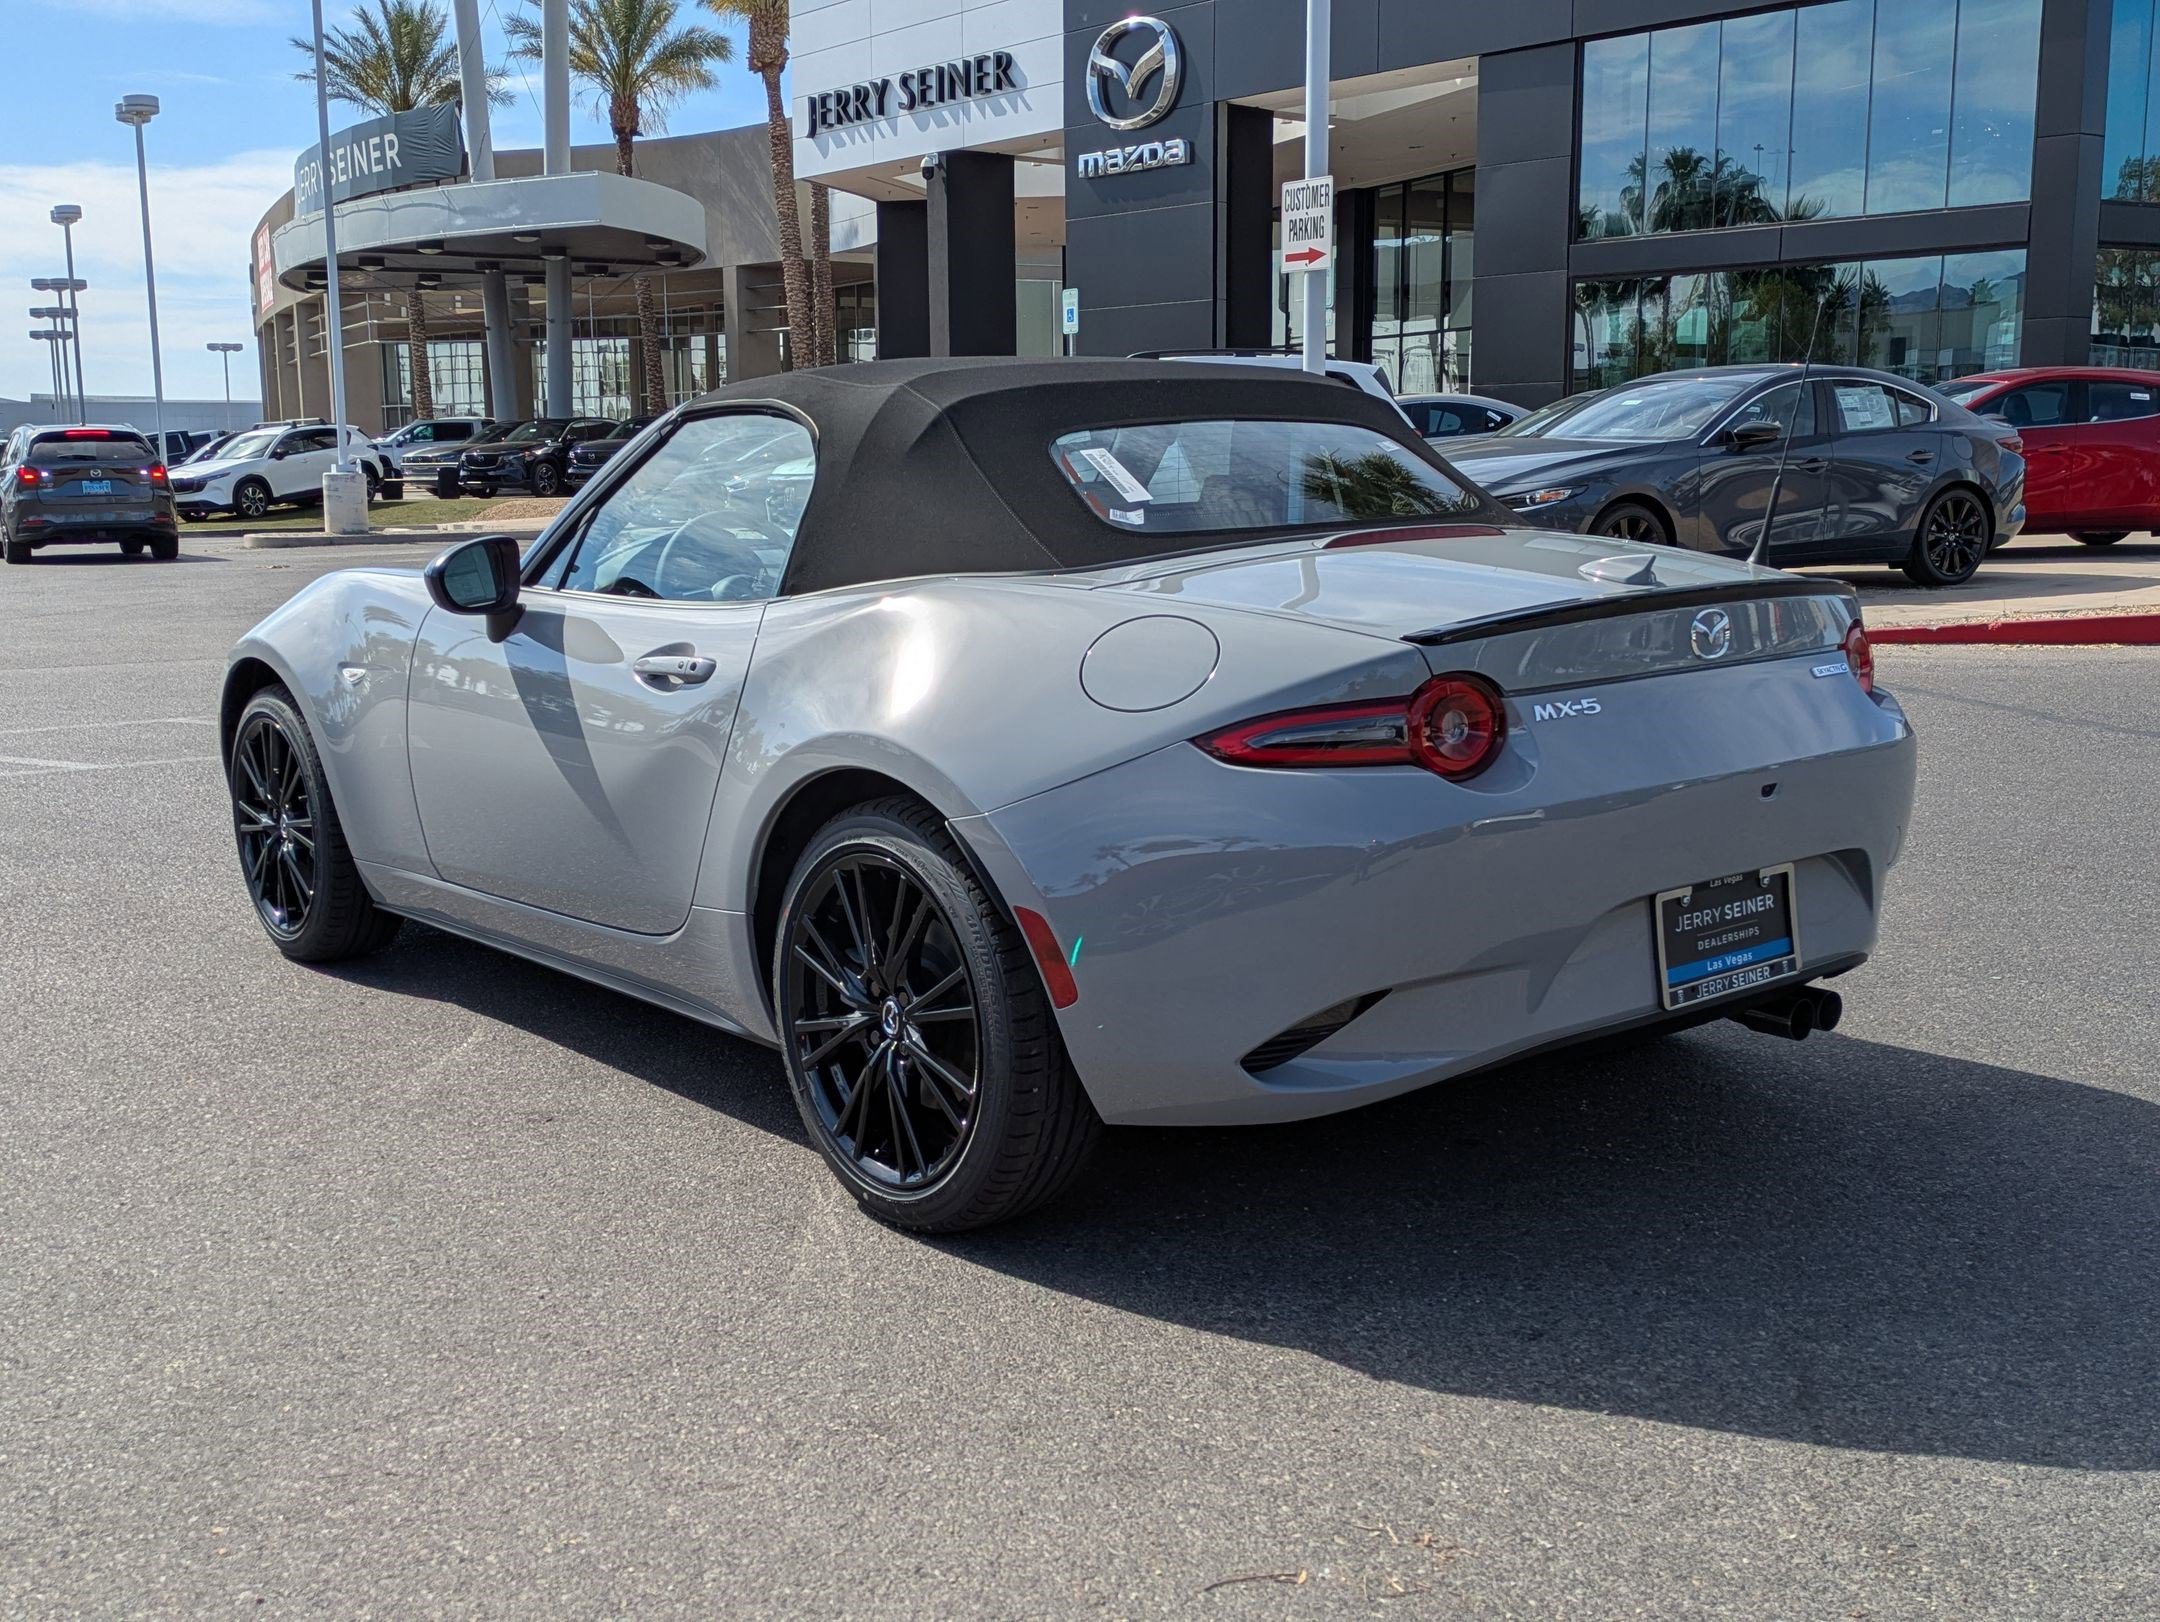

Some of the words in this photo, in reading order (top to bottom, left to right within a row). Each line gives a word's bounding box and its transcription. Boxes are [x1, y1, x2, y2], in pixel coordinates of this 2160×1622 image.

[806, 78, 890, 138] JERRY
[898, 51, 1016, 111] SEINER
[1285, 183, 1330, 213] CUSTOMER
[1288, 215, 1324, 242] PARKING
[1533, 698, 1601, 721] MX-5
[1675, 906, 1721, 932] JERRY
[1724, 894, 1775, 920] SEINER
[1698, 926, 1760, 950] DEALERSHIPS
[1707, 961, 1723, 971] Las
[1725, 952, 1753, 965] Vegas
[1696, 978, 1731, 998] JERRY
[1732, 966, 1771, 987] SEINER
